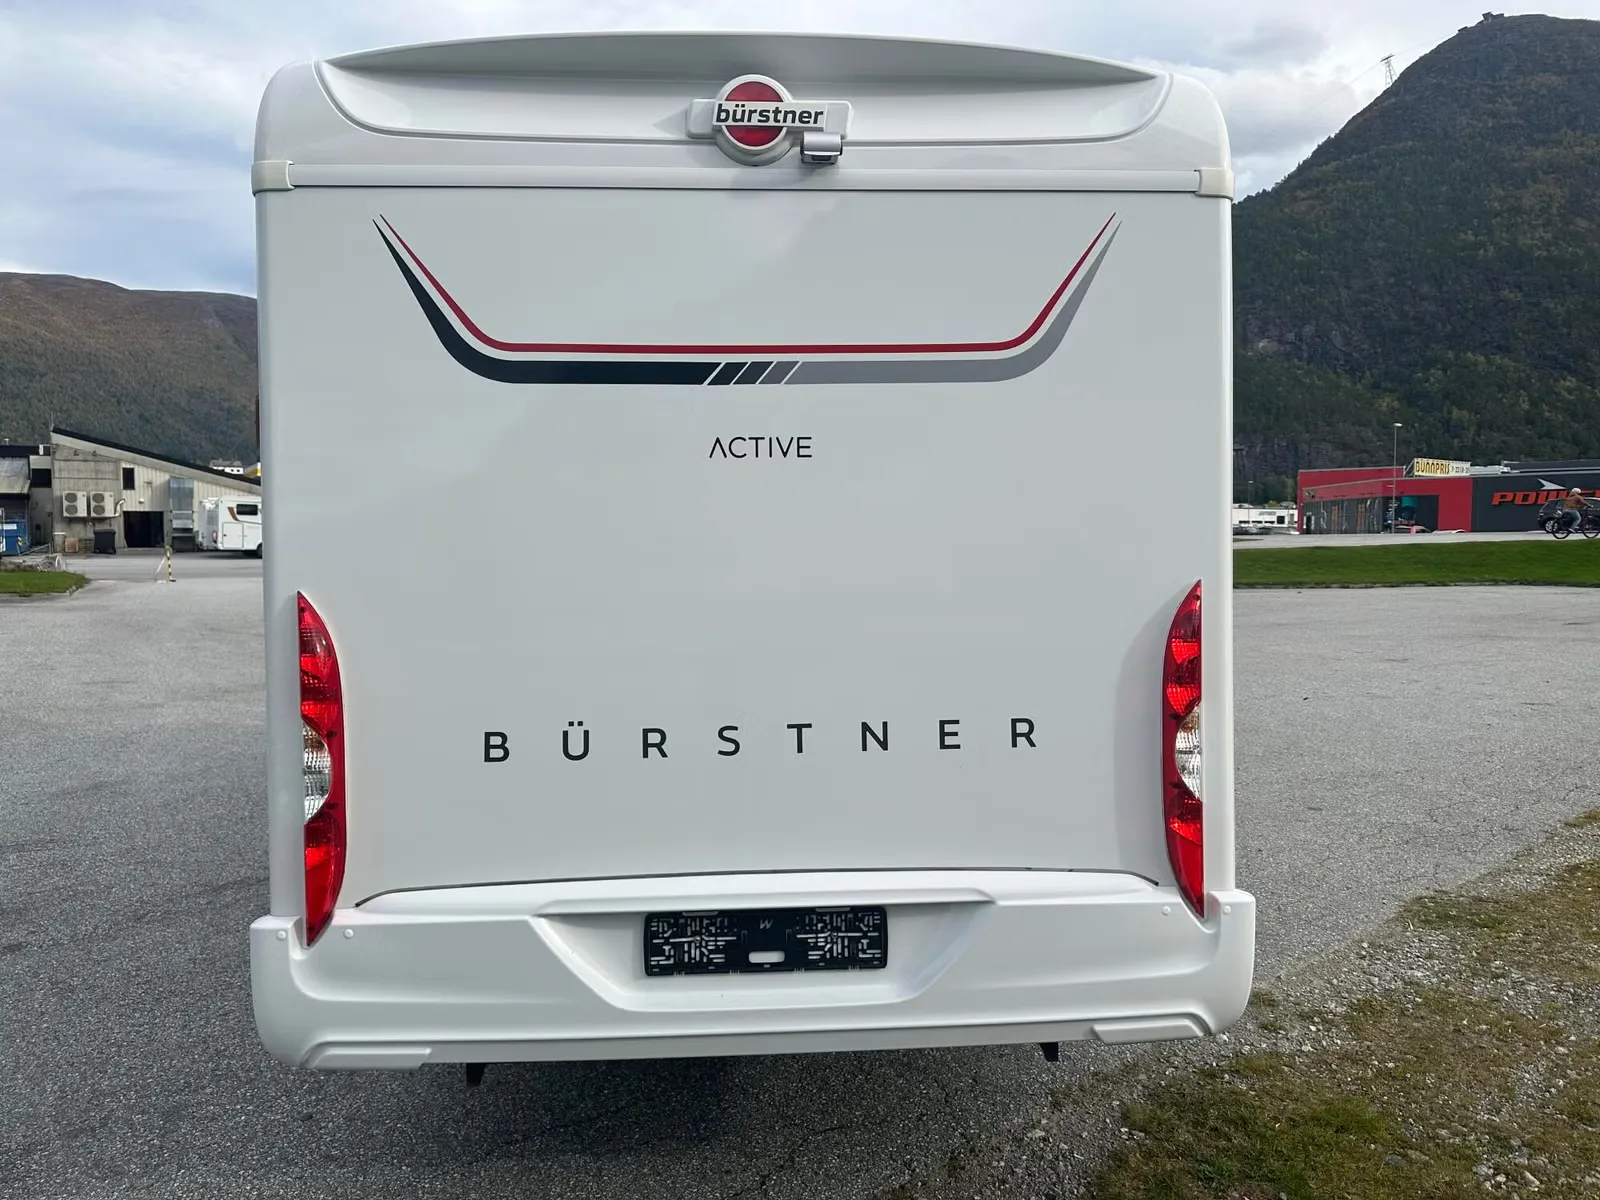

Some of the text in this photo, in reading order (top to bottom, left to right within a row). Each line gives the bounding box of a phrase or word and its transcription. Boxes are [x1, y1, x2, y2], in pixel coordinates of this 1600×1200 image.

[715, 103, 824, 126] bürstner
[708, 436, 813, 459] ACTIVE
[483, 717, 1037, 763] BÜRSTNER
